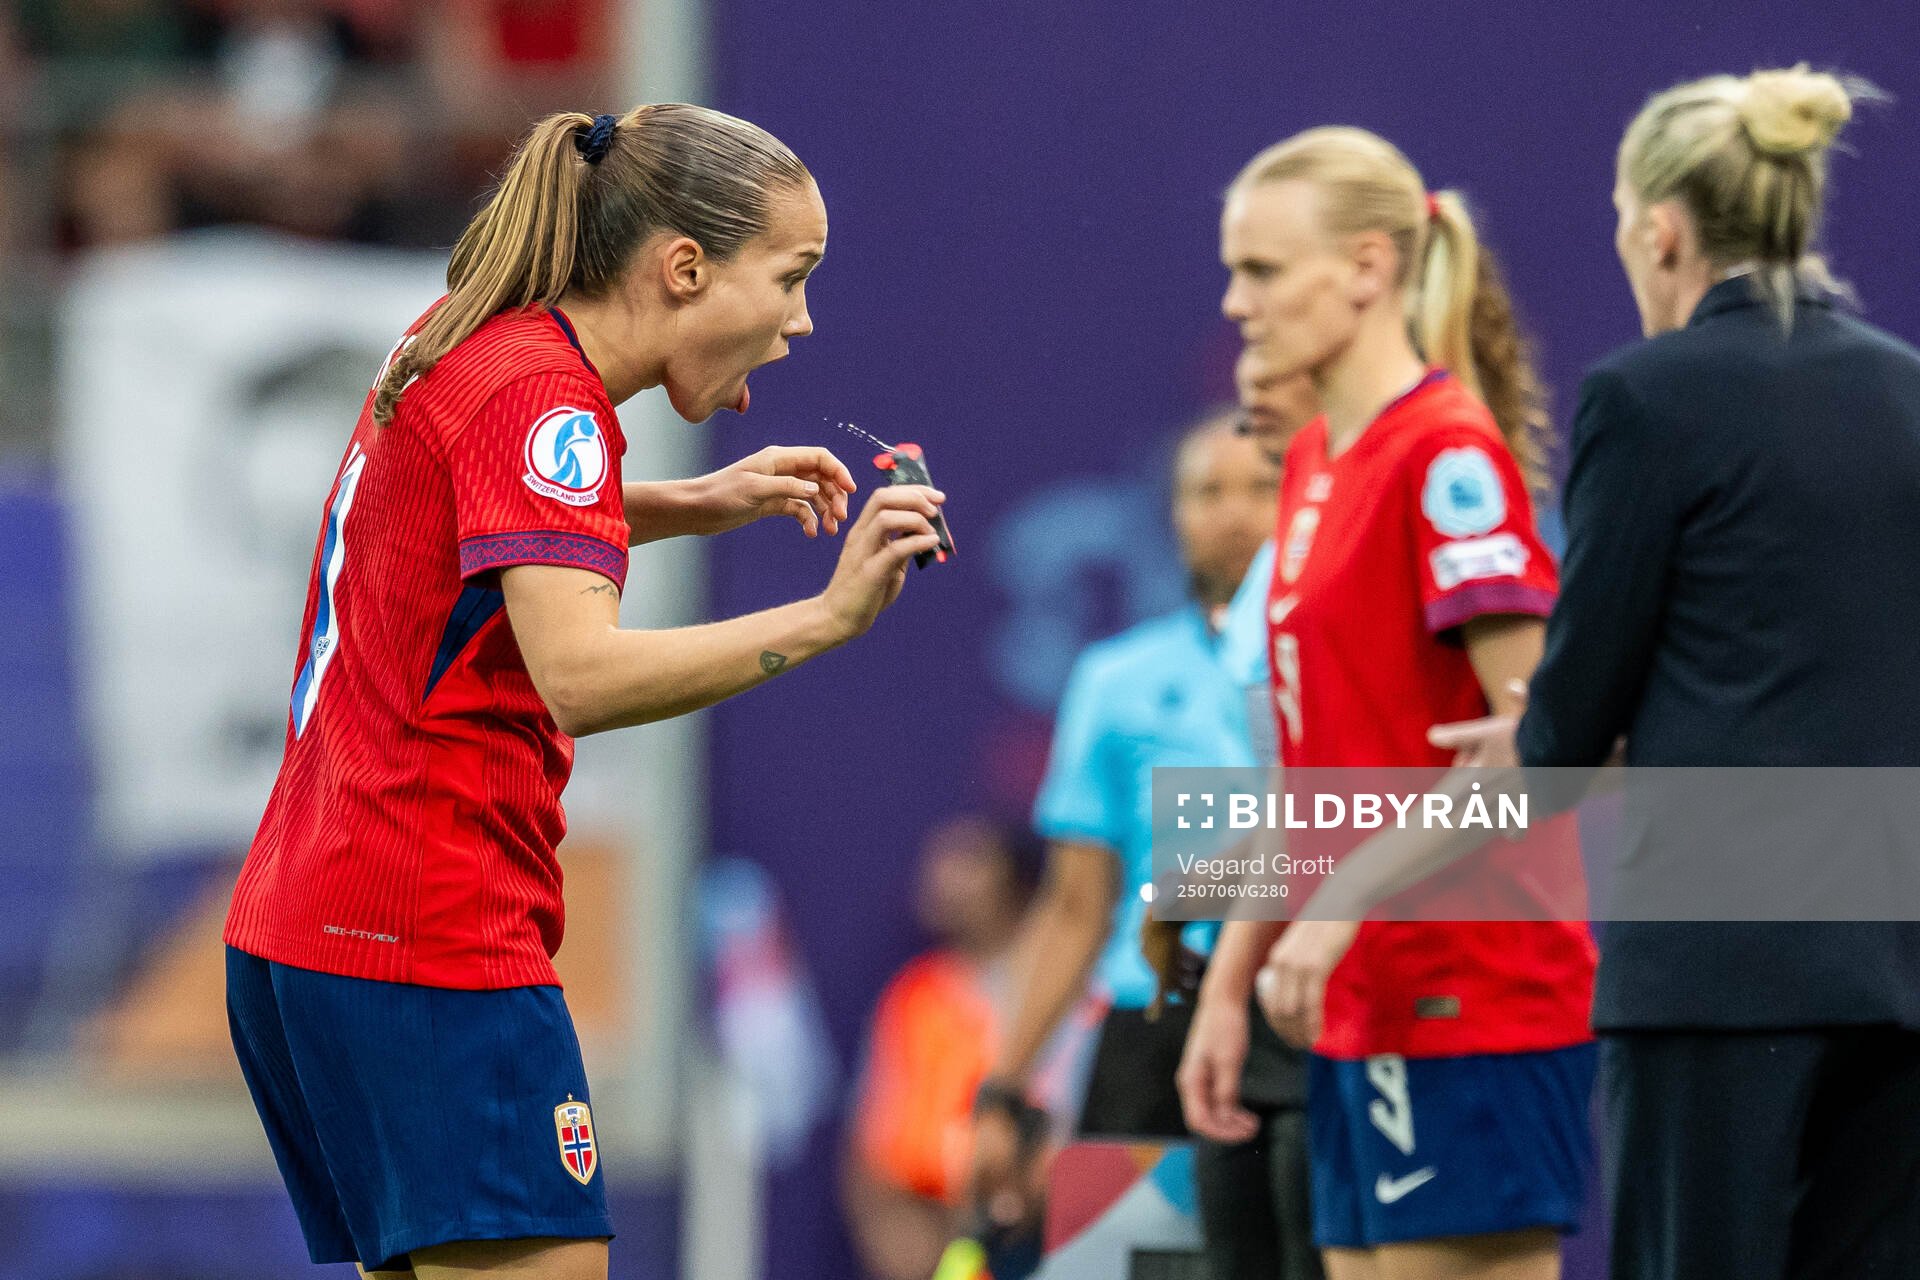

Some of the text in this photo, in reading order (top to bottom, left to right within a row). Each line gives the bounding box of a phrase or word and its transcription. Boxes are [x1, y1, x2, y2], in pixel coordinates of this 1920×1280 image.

[527, 475, 596, 503] SWITZERLAND 2025
[1366, 1054, 1416, 1156] 9
